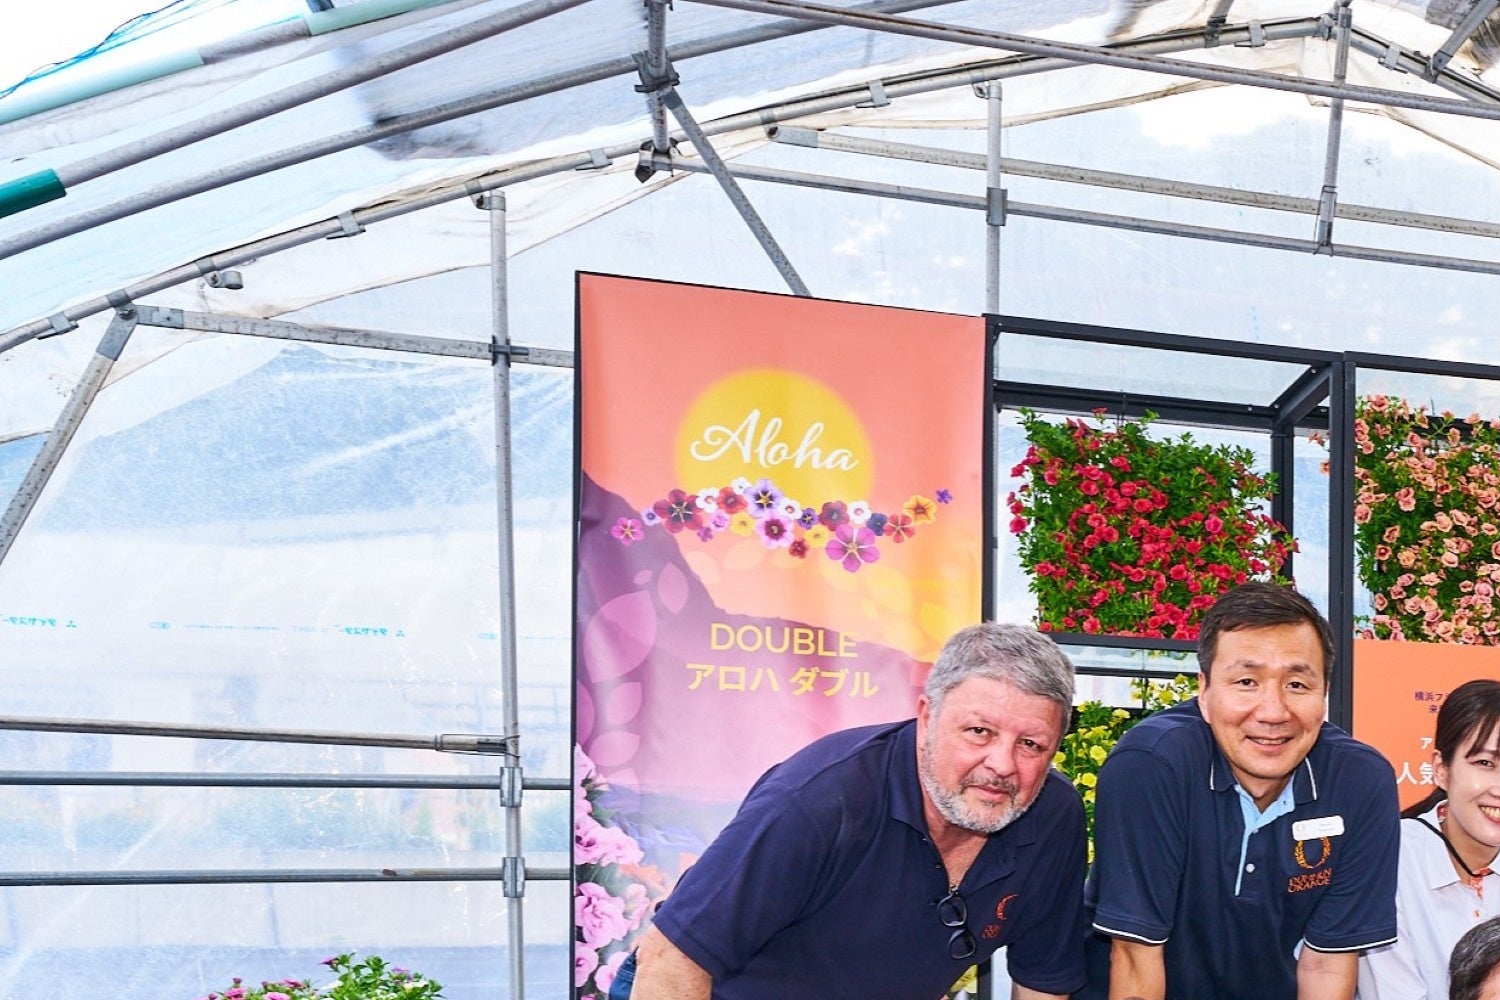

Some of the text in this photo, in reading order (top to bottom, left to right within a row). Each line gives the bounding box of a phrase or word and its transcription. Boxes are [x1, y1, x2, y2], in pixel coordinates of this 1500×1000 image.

[689, 408, 860, 472] Aloha
[710, 623, 859, 658] DOUBLE
[686, 663, 880, 698] アロハ ダブル
[1414, 691, 1450, 703] 横浜フ
